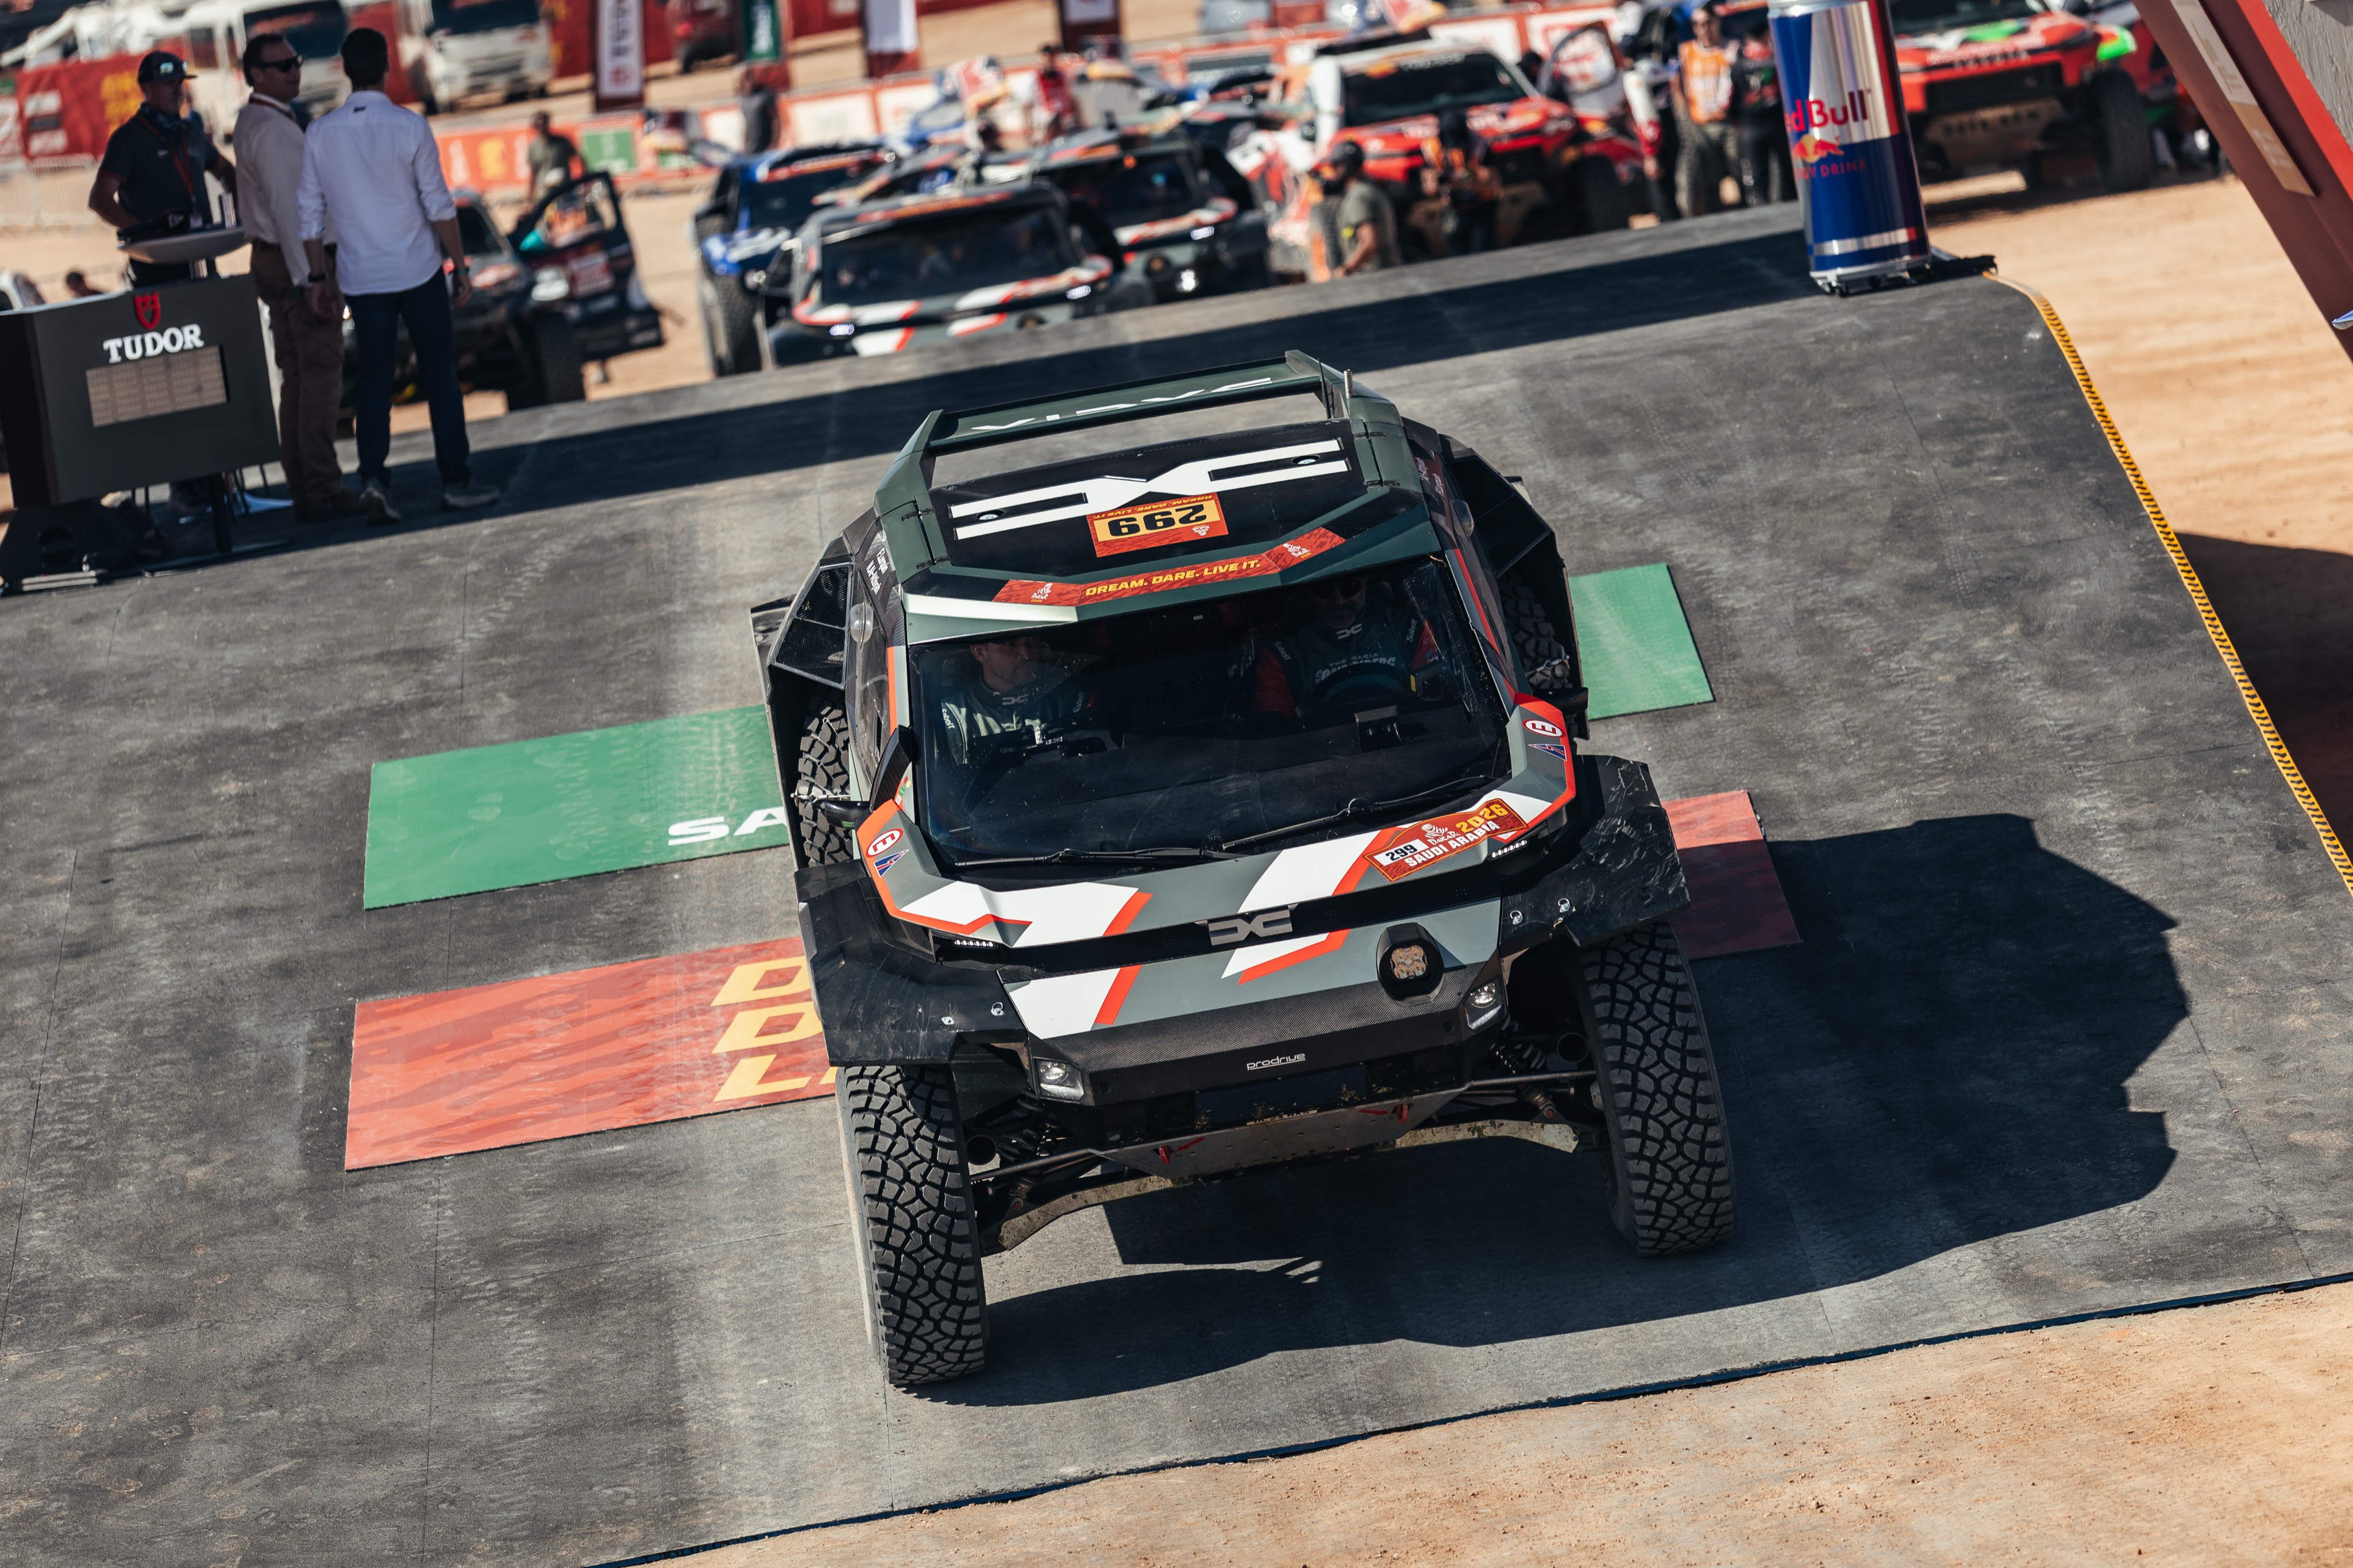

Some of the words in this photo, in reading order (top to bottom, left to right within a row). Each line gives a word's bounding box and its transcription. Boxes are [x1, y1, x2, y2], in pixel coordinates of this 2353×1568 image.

[1784, 99, 1806, 133] ed
[1806, 89, 1868, 128] Bull
[1820, 159, 1868, 177] DRINK
[103, 323, 205, 364] TUDOR
[1107, 509, 1132, 517] LIVE
[1108, 504, 1207, 537] 299
[1086, 578, 1148, 596] DREAM.
[1152, 570, 1199, 585] DARE.
[1203, 563, 1239, 576] LIVE
[1242, 560, 1261, 570] IT.
[1406, 619, 1418, 642] Sabelt
[1274, 641, 1291, 661] Sabelt
[1073, 692, 1085, 713] Sabelt
[1455, 804, 1509, 834] 2026
[1403, 844, 1449, 868] SAUDI
[1448, 820, 1500, 849] ARABIA
[1427, 831, 1461, 846] DAKAR
[1385, 844, 1418, 862] 299
[1247, 1053, 1306, 1071] prodrive
